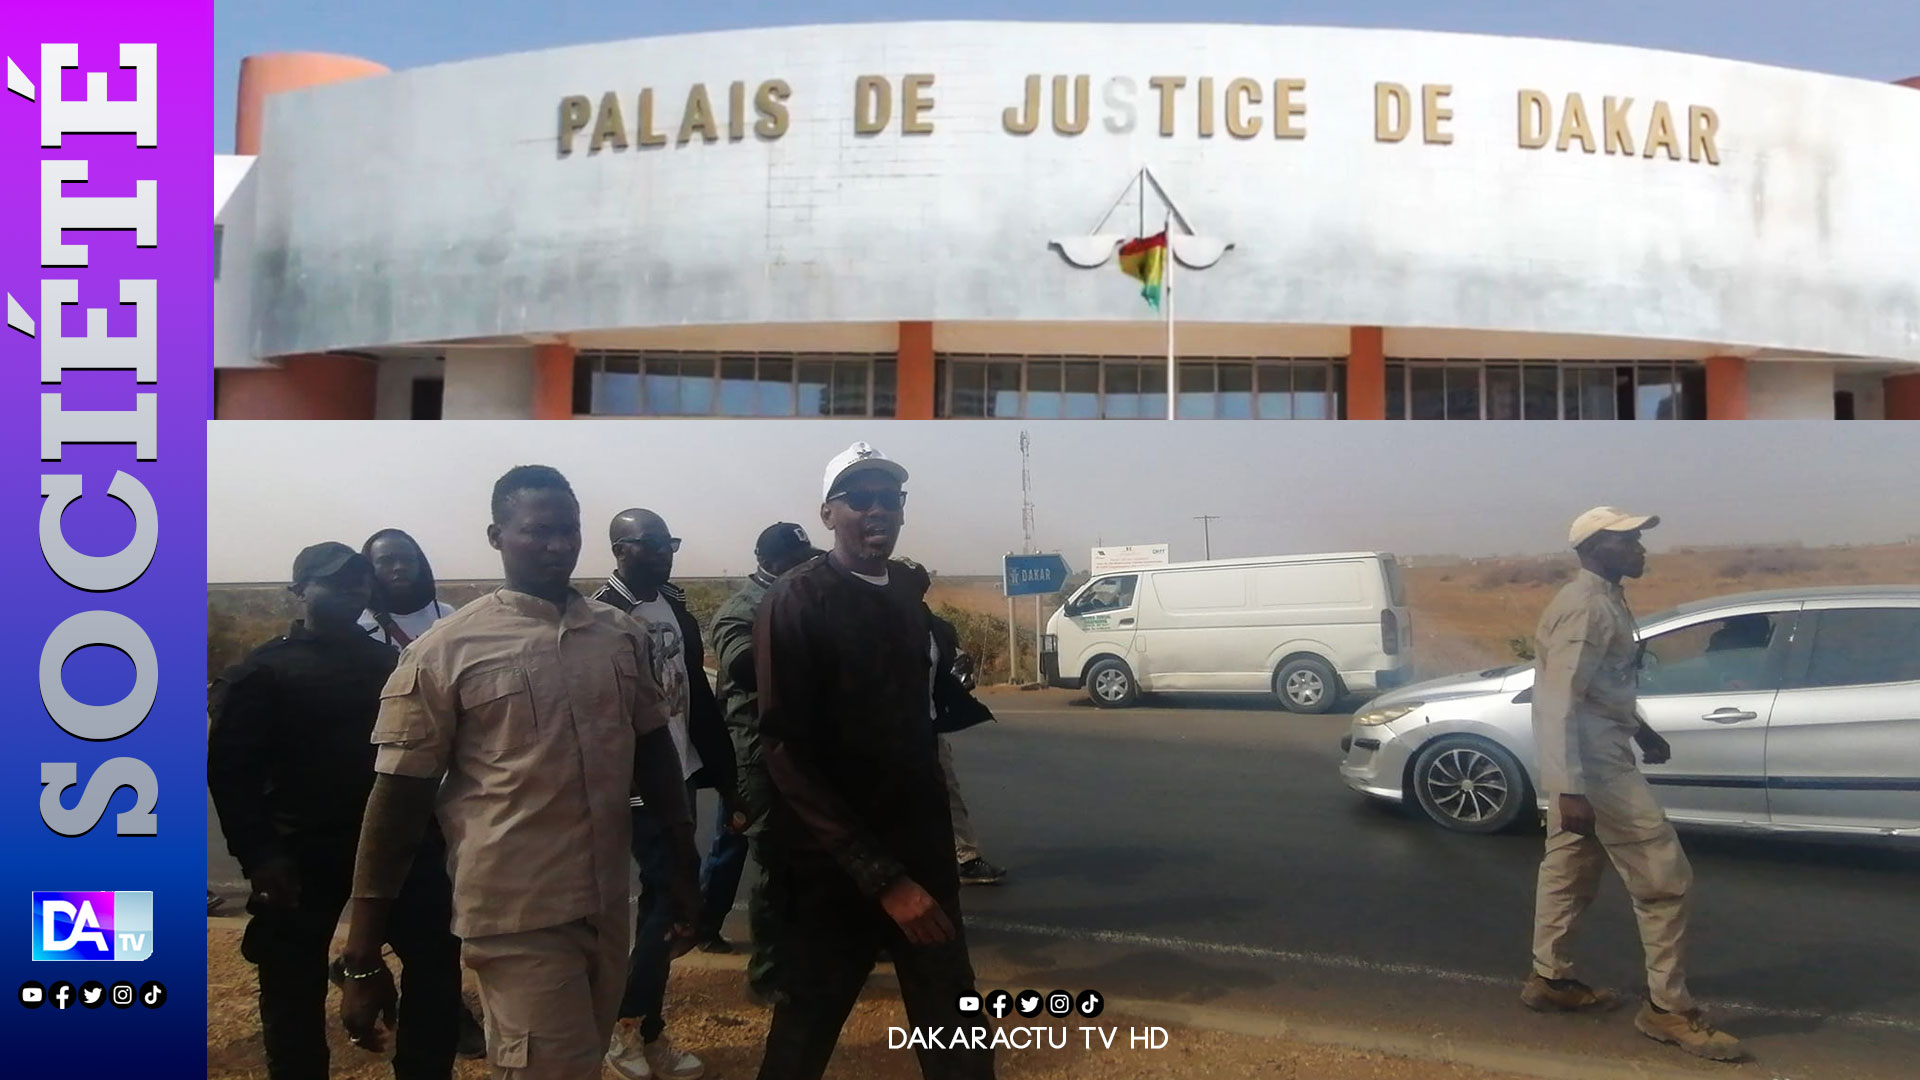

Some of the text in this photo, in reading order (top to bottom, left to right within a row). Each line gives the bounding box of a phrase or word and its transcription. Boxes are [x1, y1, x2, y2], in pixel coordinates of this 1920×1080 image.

[557, 73, 1721, 165] PALAIS DE JUSTICE DE DAKAR
[1021, 567, 1051, 582] DAKAR
